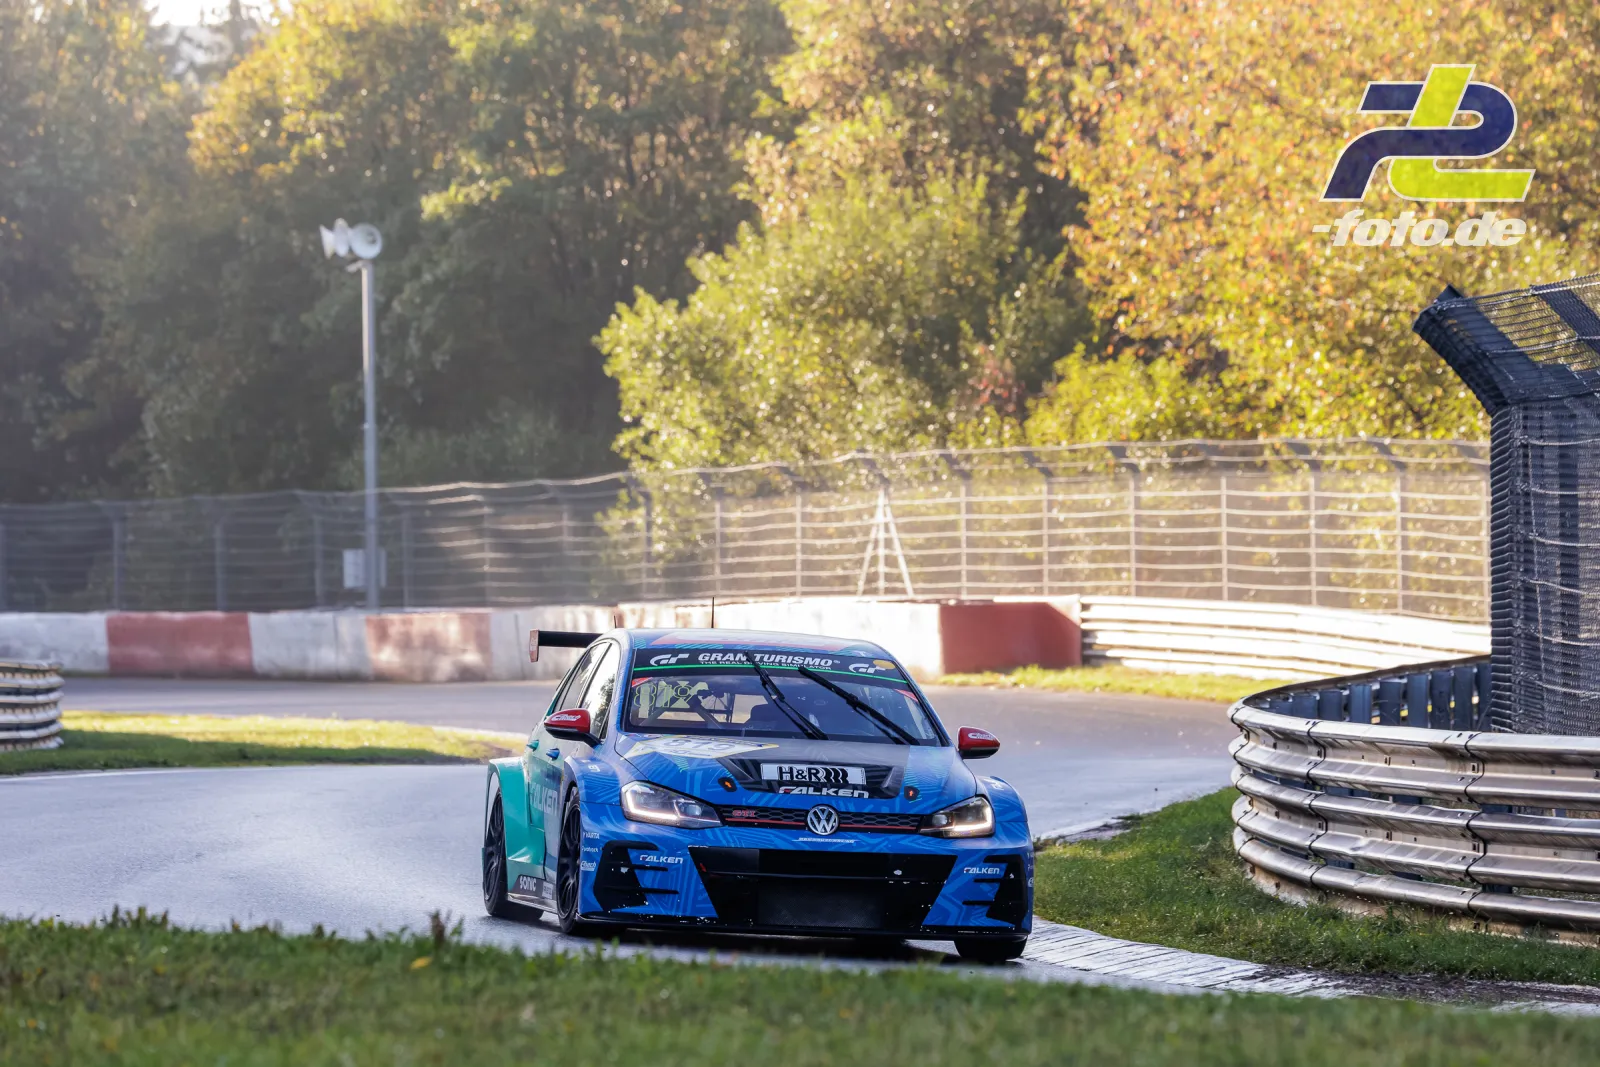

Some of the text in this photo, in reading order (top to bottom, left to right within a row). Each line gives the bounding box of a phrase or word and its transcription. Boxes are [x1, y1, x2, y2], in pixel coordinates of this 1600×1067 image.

[698, 652, 833, 667] GRAN TURISMO
[779, 786, 869, 798] FALKEN
[529, 782, 558, 816] FALKEN
[732, 809, 756, 817] GTI
[639, 854, 684, 864] FALKEN
[963, 866, 1000, 875] FALKEN
